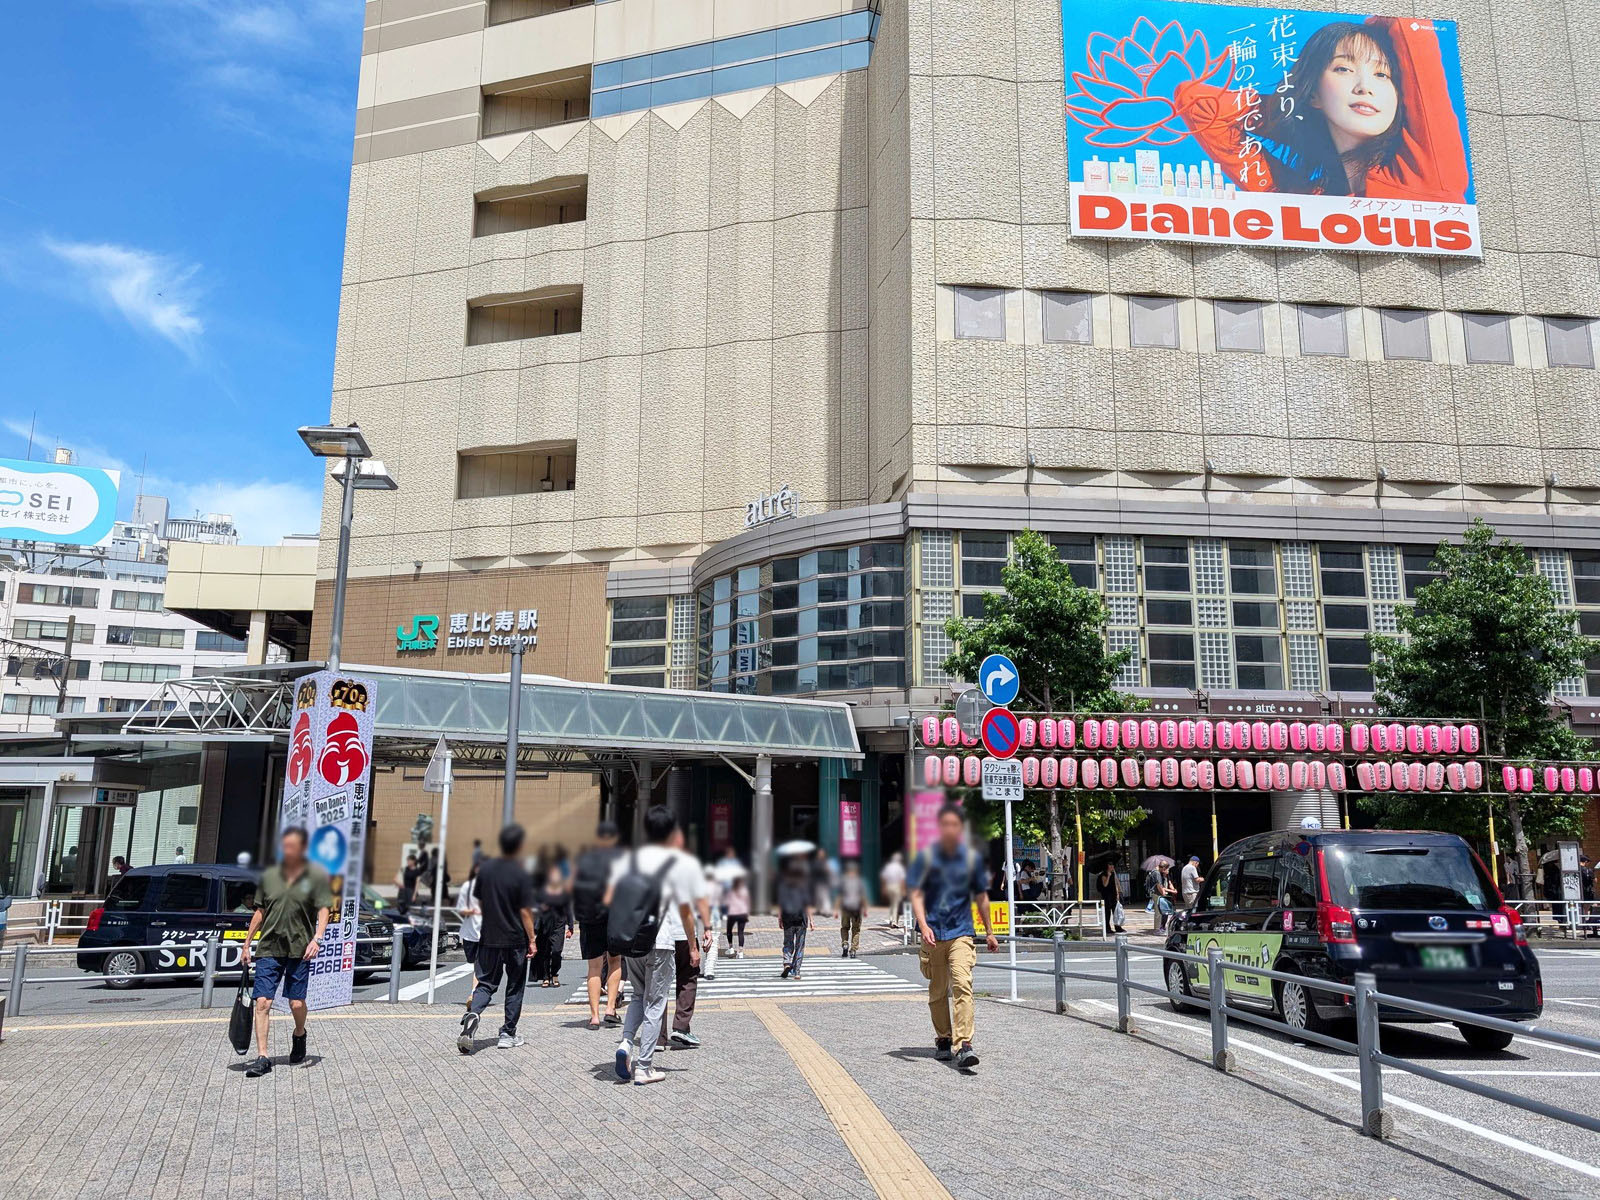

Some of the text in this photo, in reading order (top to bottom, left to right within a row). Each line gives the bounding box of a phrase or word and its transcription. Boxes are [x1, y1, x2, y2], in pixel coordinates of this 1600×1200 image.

[1265, 14, 1304, 121] 花束より、
[1226, 23, 1268, 187] 一輪の花であれ。
[1349, 199, 1464, 216] ダイアン ロータス
[1078, 194, 1472, 251] Diane Lotus
[744, 484, 792, 527] atré
[396, 615, 439, 641] JR
[449, 609, 538, 634] 恵比寿駅
[396, 640, 437, 651] JR東日本
[447, 637, 484, 648] Ebisu
[1255, 703, 1277, 713] atré
[984, 763, 1021, 774] タクシーを除く
[986, 787, 1021, 797] ここまで
[321, 807, 345, 825] 2025
